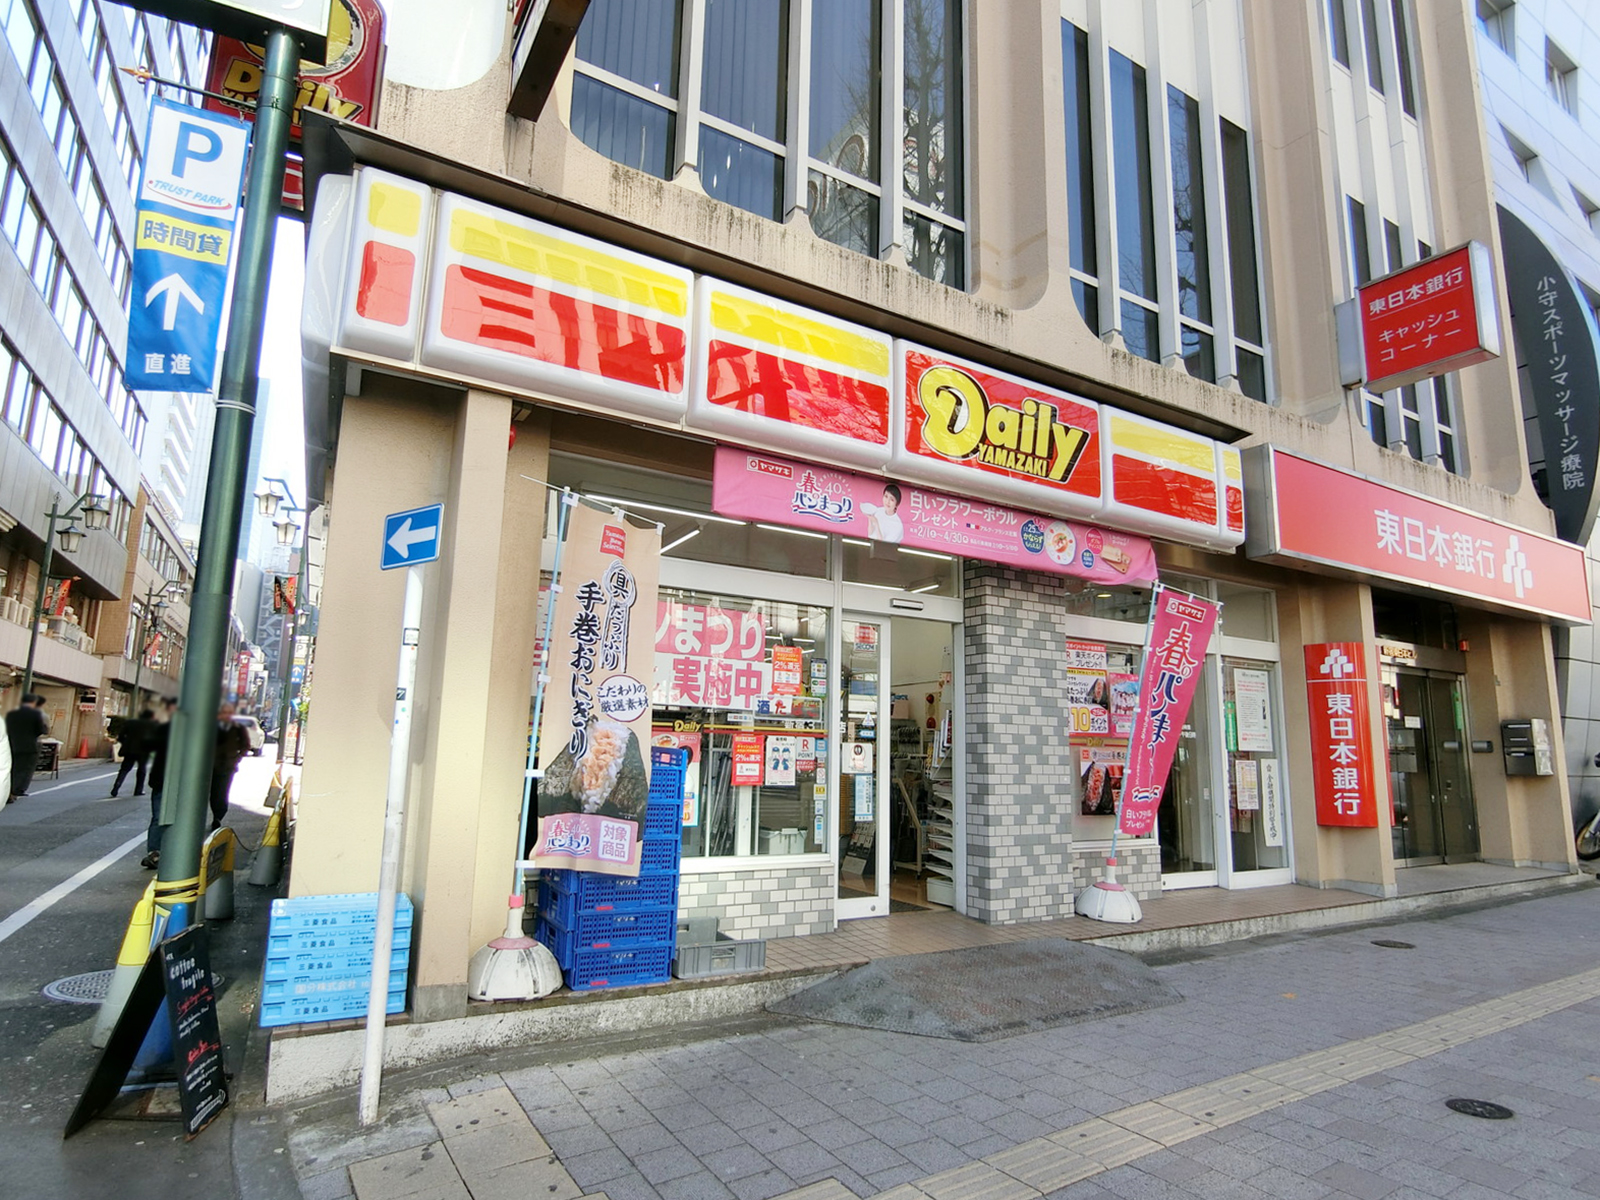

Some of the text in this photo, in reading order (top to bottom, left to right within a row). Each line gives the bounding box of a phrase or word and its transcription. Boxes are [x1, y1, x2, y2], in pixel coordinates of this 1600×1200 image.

[223, 59, 363, 121] Dily
[171, 121, 223, 178] P
[153, 180, 225, 206] TRUST PARK
[143, 219, 223, 256] 時間貸
[1368, 267, 1464, 316] 東日本銀行
[1378, 310, 1460, 343] キャッシュ
[1380, 328, 1461, 362] コーナー
[144, 352, 192, 375] 直進
[1536, 275, 1585, 490] 小守スポーツマッサージ療院
[919, 365, 1084, 481] Daily
[759, 461, 791, 476] ヤマザキ
[978, 443, 1047, 477] YAMAZAKI
[794, 492, 852, 514] パンまつり
[910, 491, 1018, 525] 白いフラワーボウル
[910, 509, 958, 529] プレゼント
[1374, 508, 1494, 579] 東日本銀行
[604, 569, 630, 668] 具たっぷり
[1179, 604, 1203, 619] ヤマザキ
[570, 582, 603, 762] 手巻おにぎり
[673, 657, 763, 708] 実施中
[596, 683, 647, 698] こだわりの
[757, 700, 770, 714] 酒
[1071, 707, 1090, 731] 10
[674, 721, 701, 732] Daily
[802, 739, 809, 749] R
[1325, 692, 1361, 815] 東日本銀行
[604, 824, 627, 842] 対象
[602, 841, 625, 858] 商品
[303, 917, 337, 926] 三菱食品
[301, 939, 335, 948] 三菱食品
[299, 961, 333, 970] 三菱食品
[294, 1005, 328, 1015] 三菱食品
